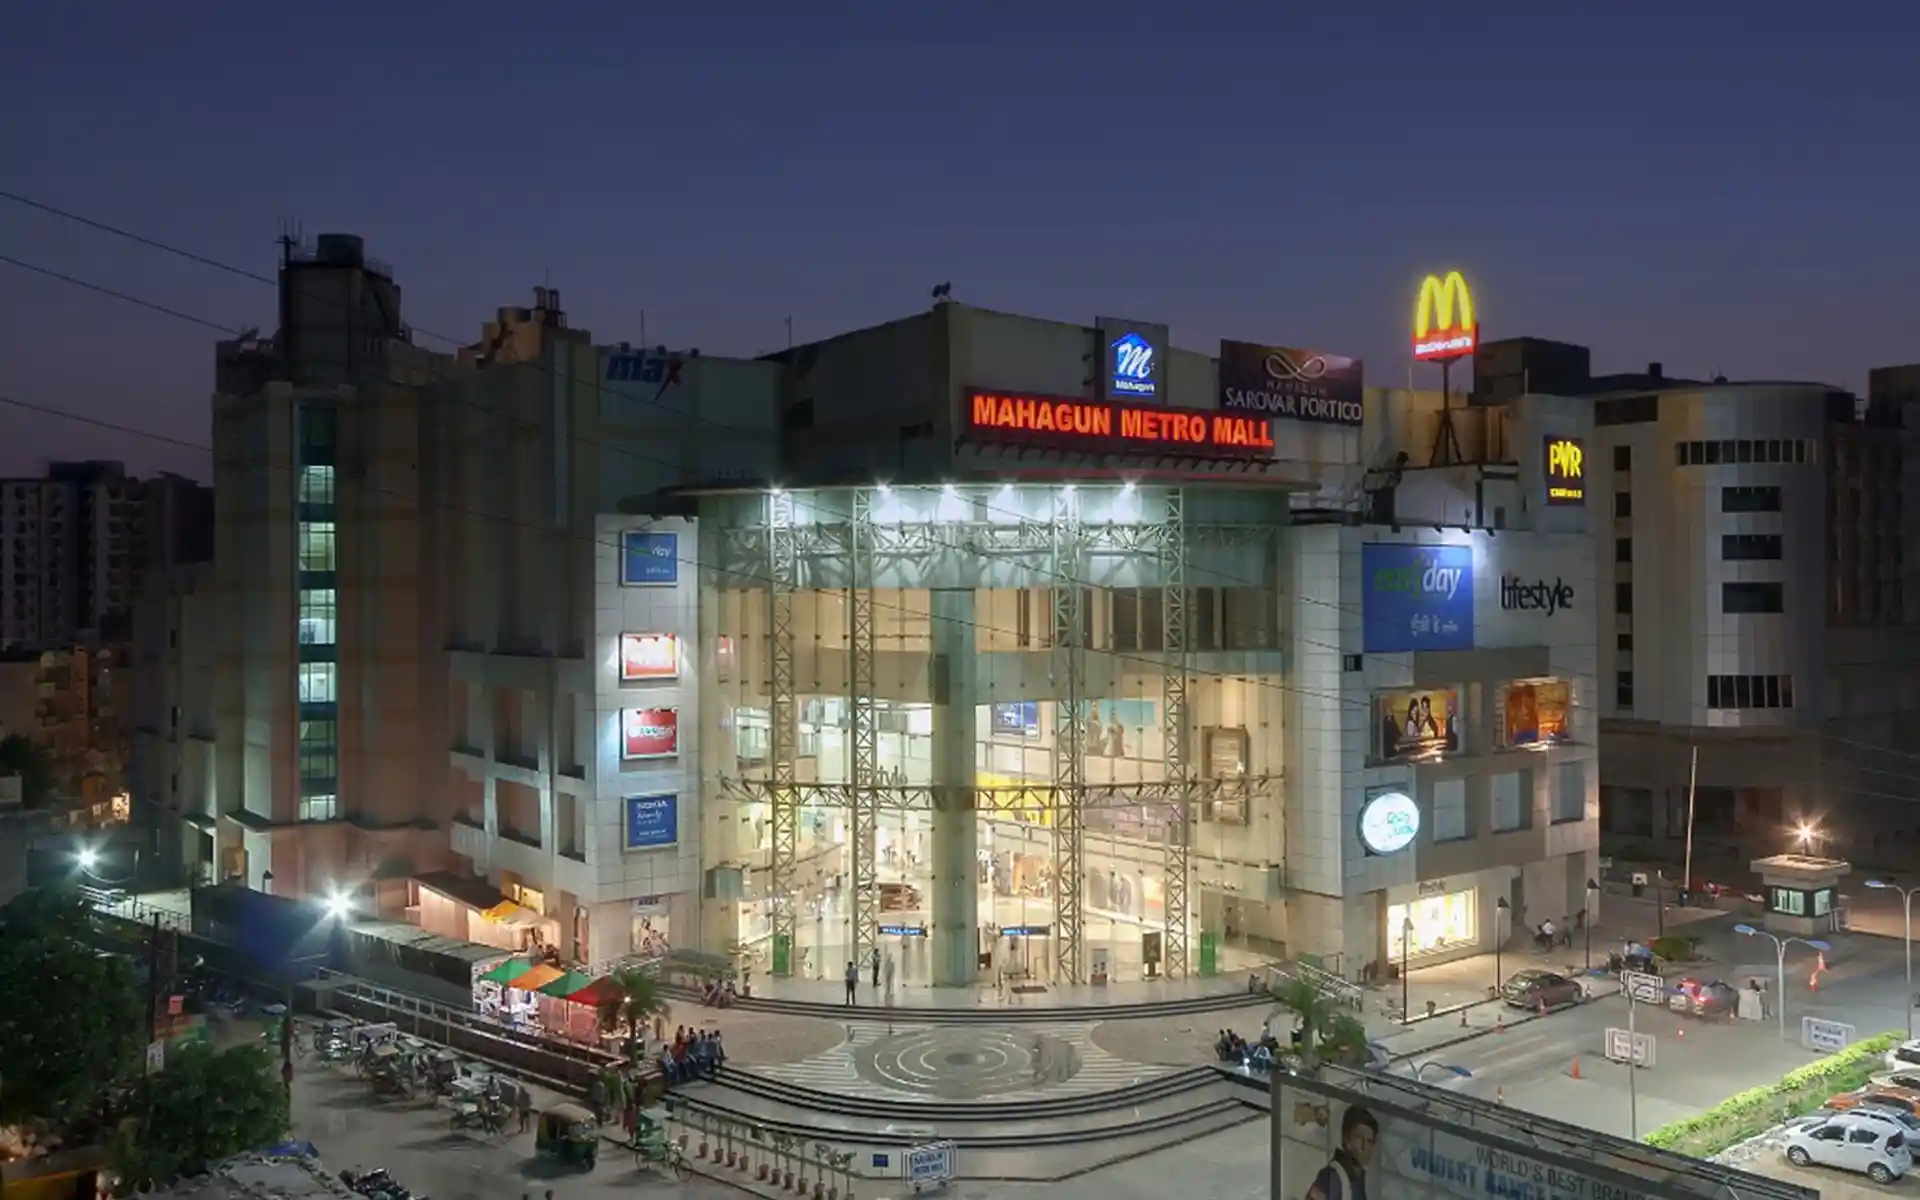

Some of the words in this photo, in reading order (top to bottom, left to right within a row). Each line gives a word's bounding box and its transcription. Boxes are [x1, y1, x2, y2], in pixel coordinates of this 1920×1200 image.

[972, 395, 1111, 436] MAHAGUN
[1120, 409, 1206, 443] METRO
[1213, 417, 1274, 447] MALL
[1225, 387, 1296, 415] SAROVAR
[1300, 397, 1362, 421] PORTICO
[1549, 440, 1583, 479] PVR
[1500, 575, 1574, 617] lifestyle
[1476, 1147, 1544, 1183] WORLD'S
[1547, 1168, 1589, 1196] BEST
